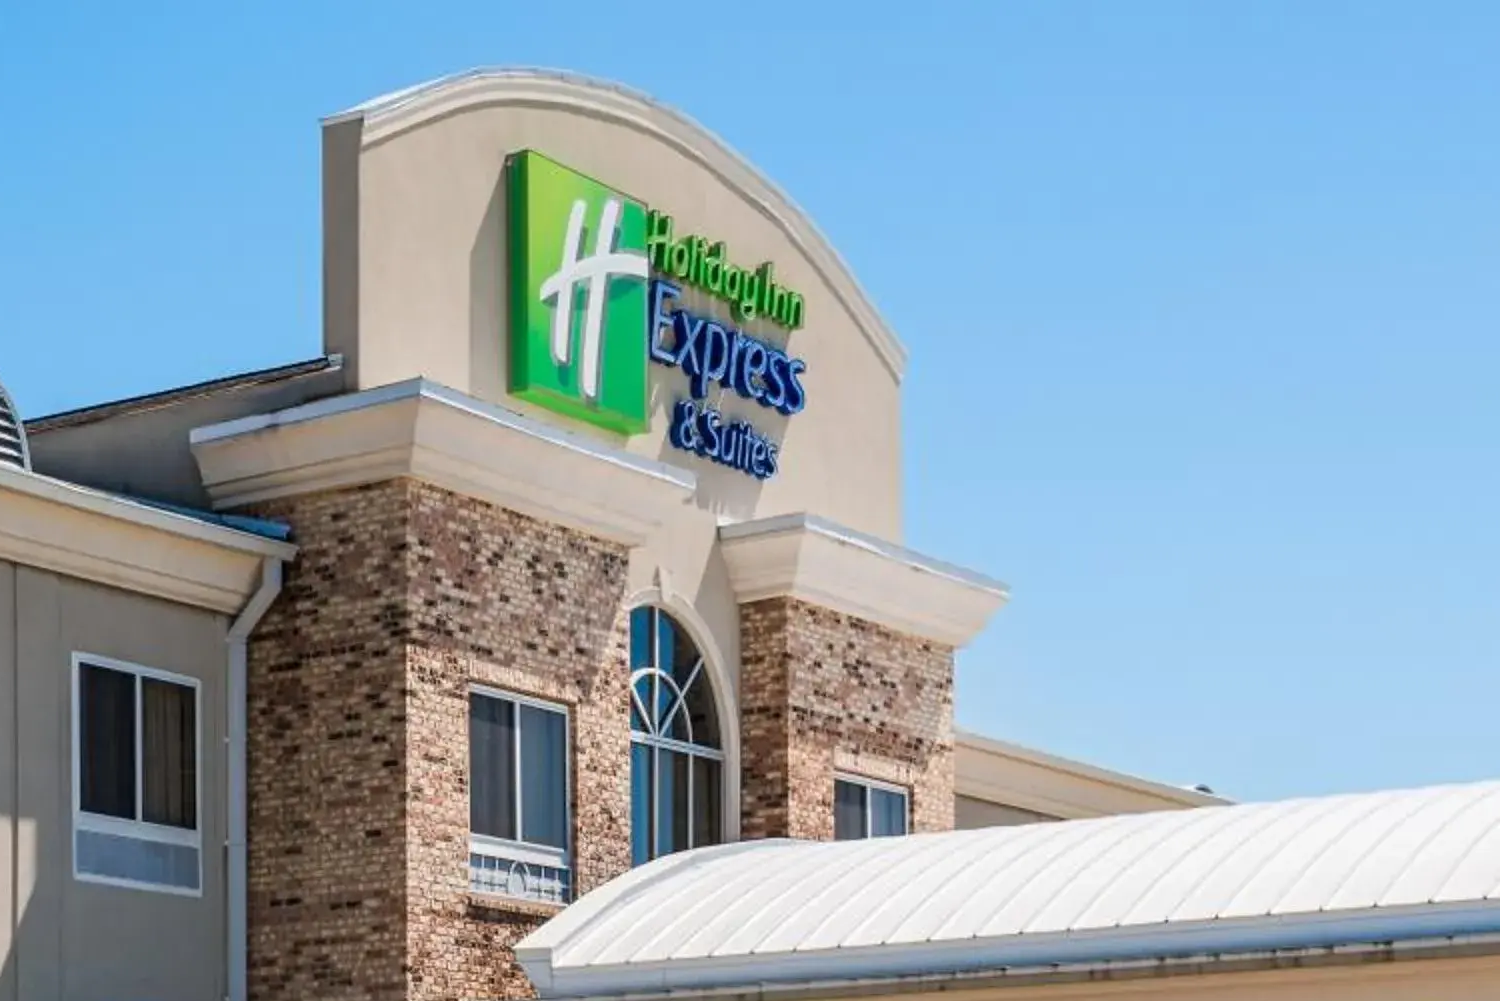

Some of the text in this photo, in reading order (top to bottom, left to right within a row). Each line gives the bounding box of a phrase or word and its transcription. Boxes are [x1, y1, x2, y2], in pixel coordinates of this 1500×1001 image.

[647, 209, 805, 330] Holiday Inn
[650, 279, 807, 416] Express
[671, 400, 779, 480] & Suites
